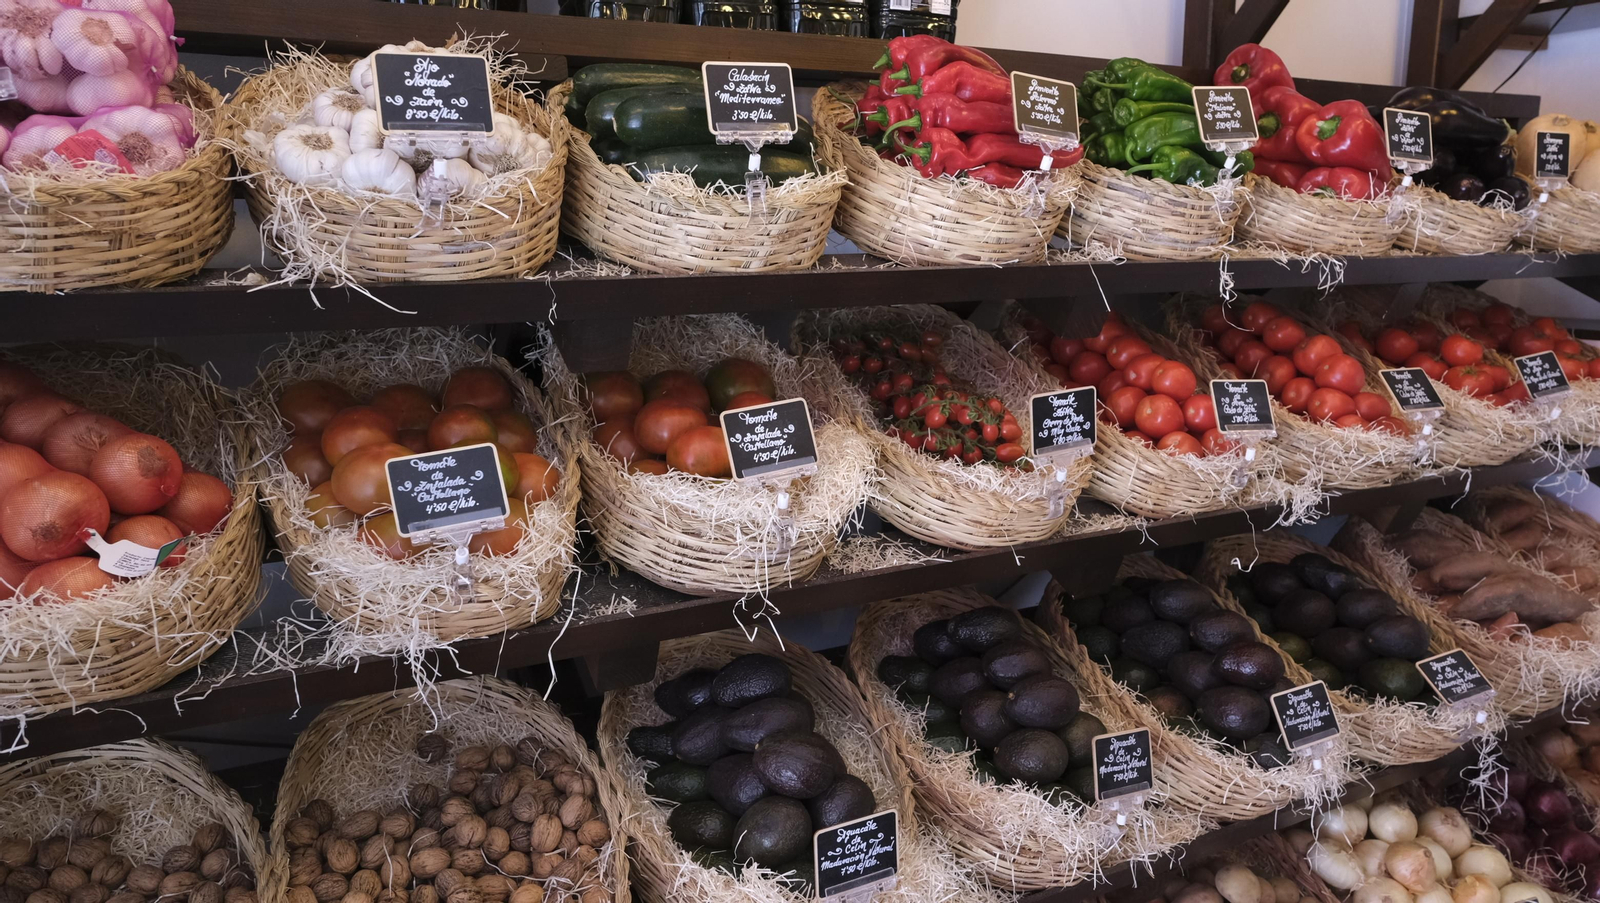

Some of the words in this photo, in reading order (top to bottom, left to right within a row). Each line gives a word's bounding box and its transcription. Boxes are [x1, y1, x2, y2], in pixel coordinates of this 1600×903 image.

[413, 57, 440, 80] Ajo
[422, 87, 436, 97] de
[1224, 381, 1248, 394] Tomate
[1048, 393, 1078, 407] Tomate
[738, 408, 778, 425] Tomate
[754, 424, 765, 433] de
[410, 456, 457, 472] Tomate
[753, 452, 770, 463] 4'50
[431, 471, 444, 481] de
[426, 502, 447, 514] 4'50
[1287, 688, 1313, 707] Aguacate
[1110, 734, 1137, 755] Aguacate
[1118, 748, 1125, 756] de
[836, 820, 878, 843] Aguacate
[851, 835, 862, 845] de
